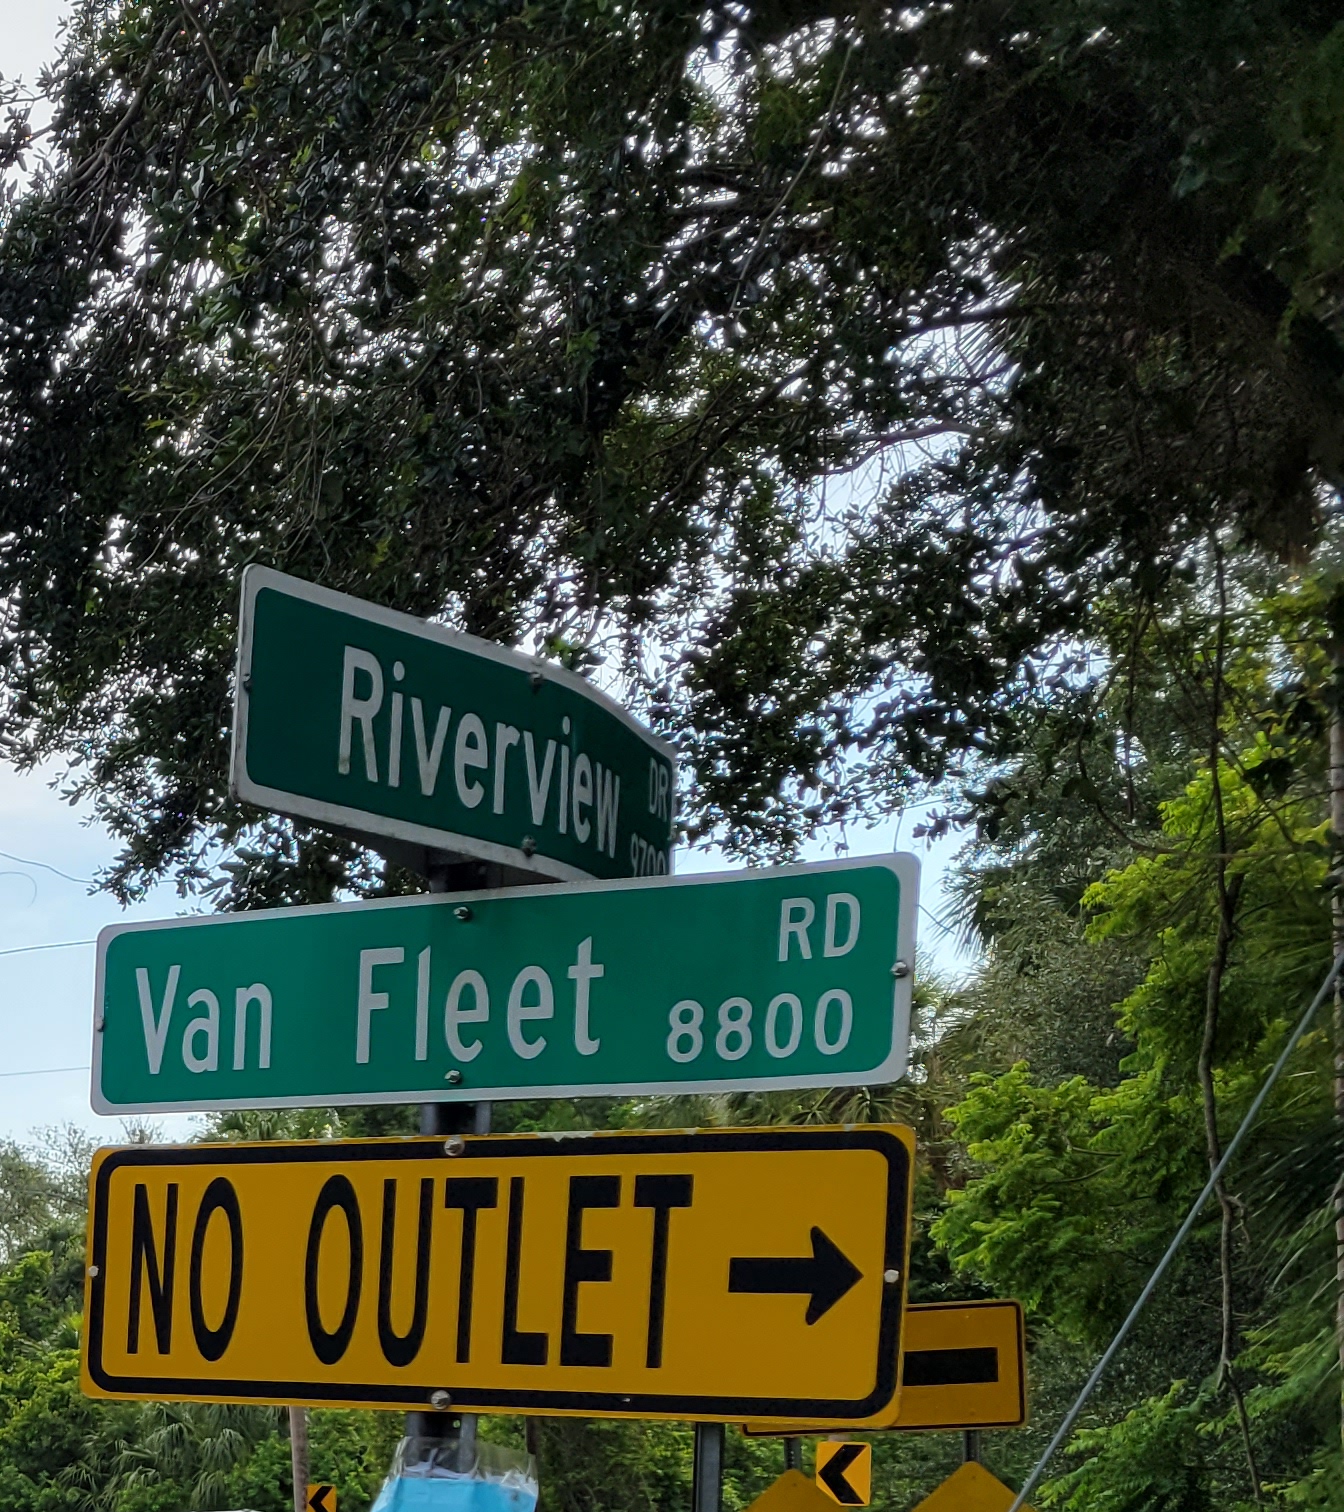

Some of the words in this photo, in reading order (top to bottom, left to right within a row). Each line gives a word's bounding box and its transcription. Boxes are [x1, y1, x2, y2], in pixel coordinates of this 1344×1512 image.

[338, 645, 621, 859] Riverview
[649, 757, 669, 822] DR
[631, 832, 666, 877] 9700
[778, 892, 861, 961] RD
[135, 965, 273, 1075] Van
[355, 936, 604, 1064] Fleet
[666, 989, 854, 1063] 8800
[126, 1175, 243, 1363] NO
[304, 1172, 694, 1369] OUTLET
